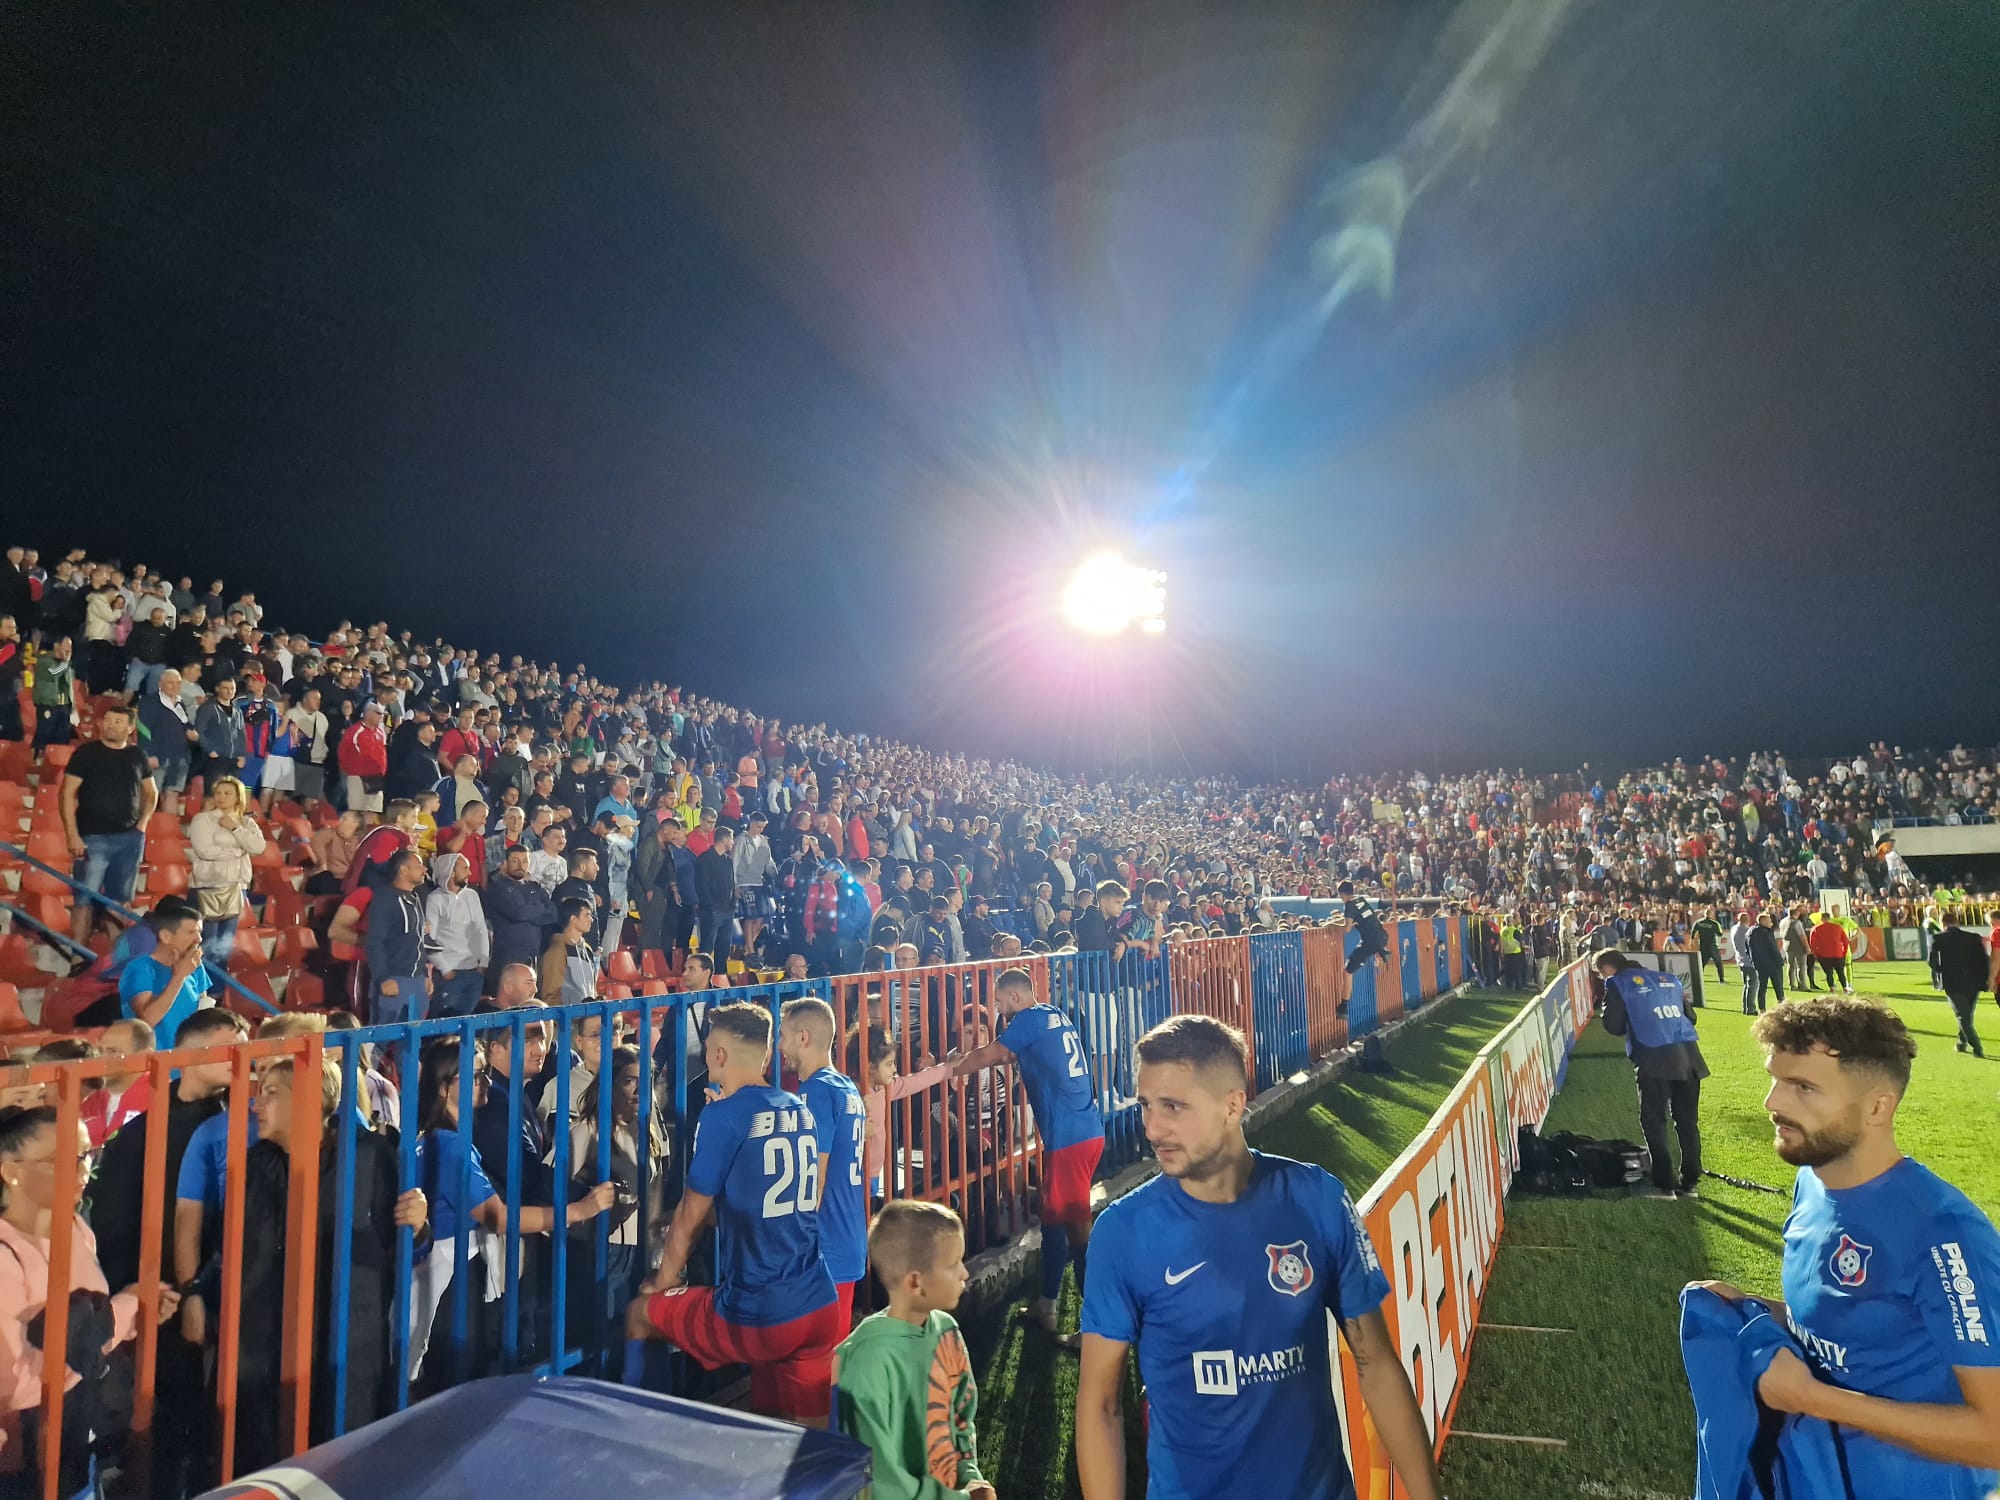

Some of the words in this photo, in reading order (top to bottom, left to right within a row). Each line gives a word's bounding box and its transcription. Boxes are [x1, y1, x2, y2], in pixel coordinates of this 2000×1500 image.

[1653, 1004, 1682, 1020] 108
[762, 1134, 818, 1219] 26
[1388, 1078, 1498, 1448] BETANO
[1941, 1242, 1988, 1344] PROLINE
[1238, 1344, 1305, 1376] MARTY
